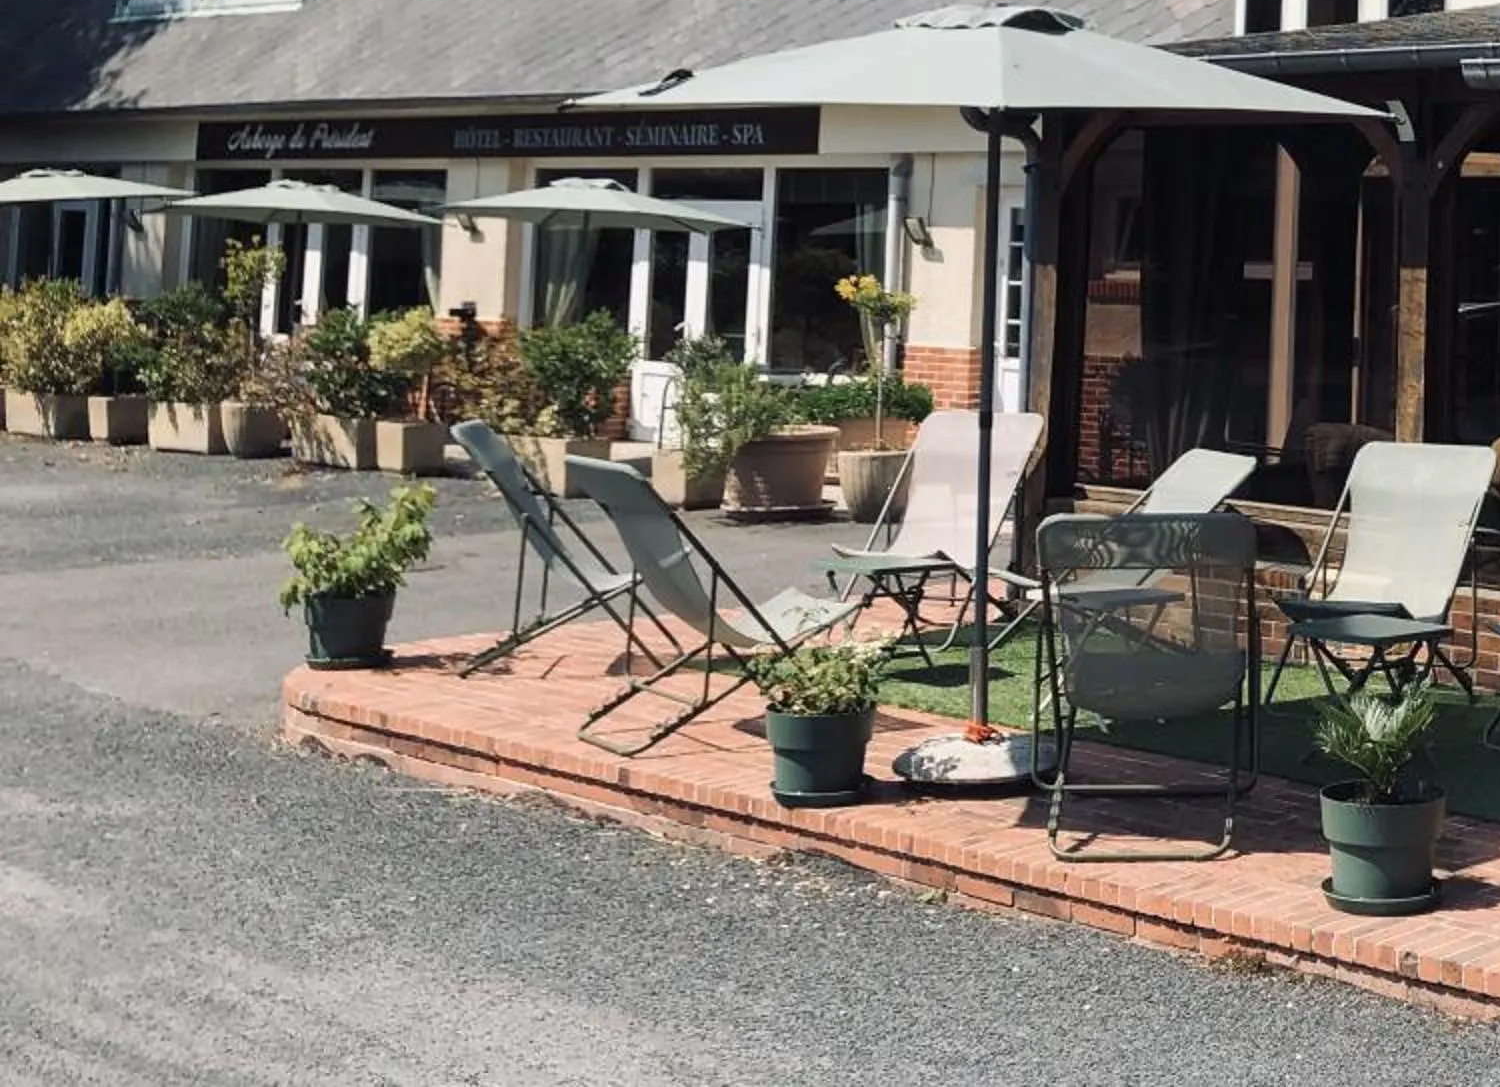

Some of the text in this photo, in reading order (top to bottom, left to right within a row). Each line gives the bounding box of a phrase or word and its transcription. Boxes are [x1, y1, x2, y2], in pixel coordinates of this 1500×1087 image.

[453, 124, 501, 149] HÔTEL
[512, 126, 615, 148] RESTAURANT
[625, 118, 719, 146] SÉMINAIRE
[731, 122, 765, 145] SPA
